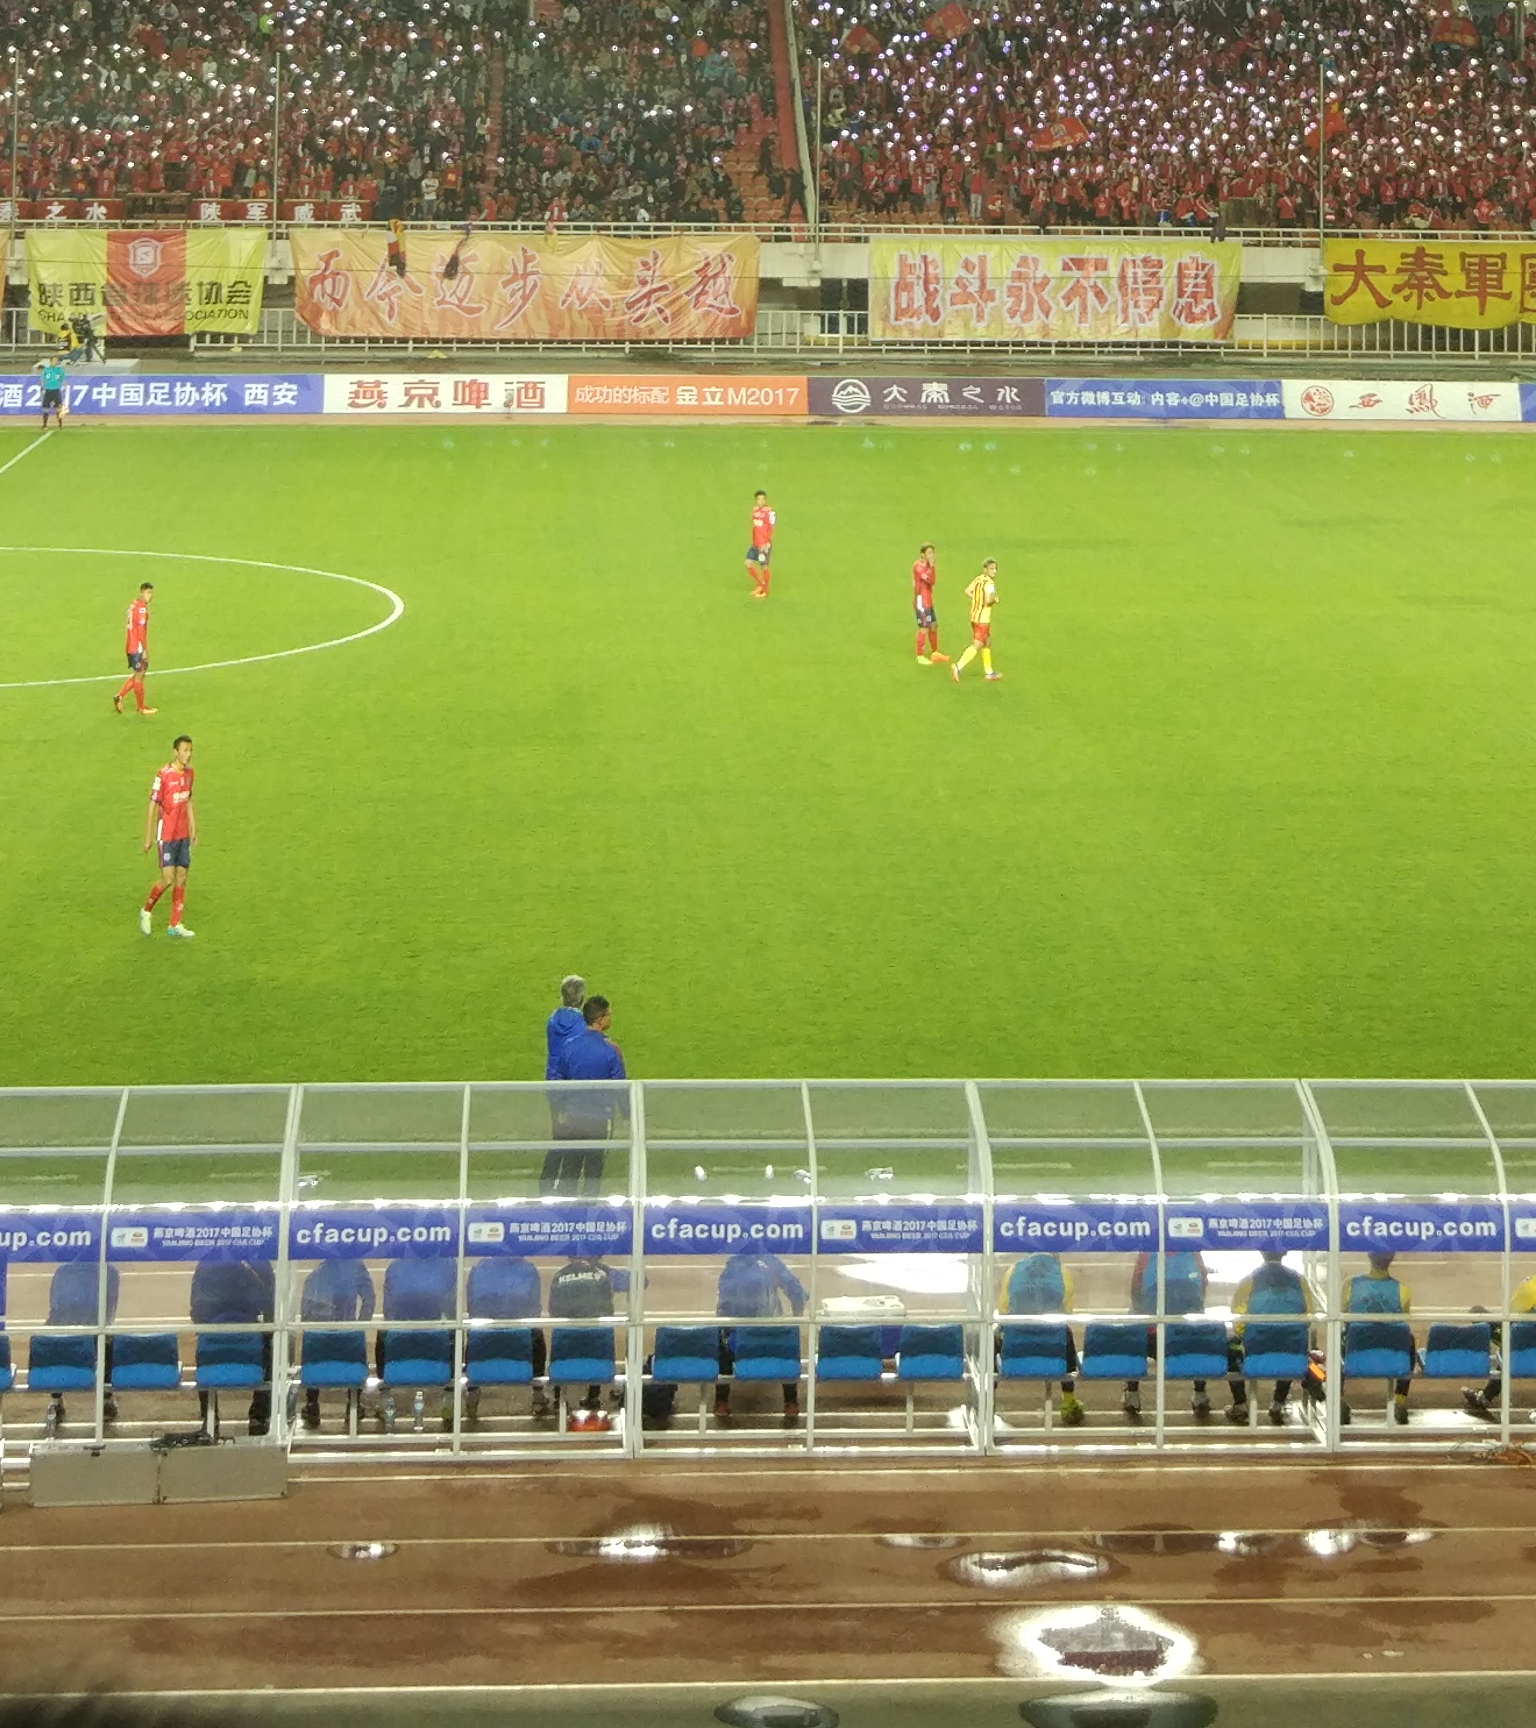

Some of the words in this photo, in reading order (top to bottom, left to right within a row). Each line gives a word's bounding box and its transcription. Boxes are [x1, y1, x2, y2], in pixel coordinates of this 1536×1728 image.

[890, 252, 1223, 327] 战斗永不停息
[244, 384, 299, 407] 西安
[348, 379, 547, 410] 燕京啤酒
[296, 1222, 452, 1245] cfacup.com
[651, 1217, 804, 1244] cfacup.com
[999, 1216, 1152, 1240] cfacup.com
[1345, 1216, 1497, 1240] cfacup.com
